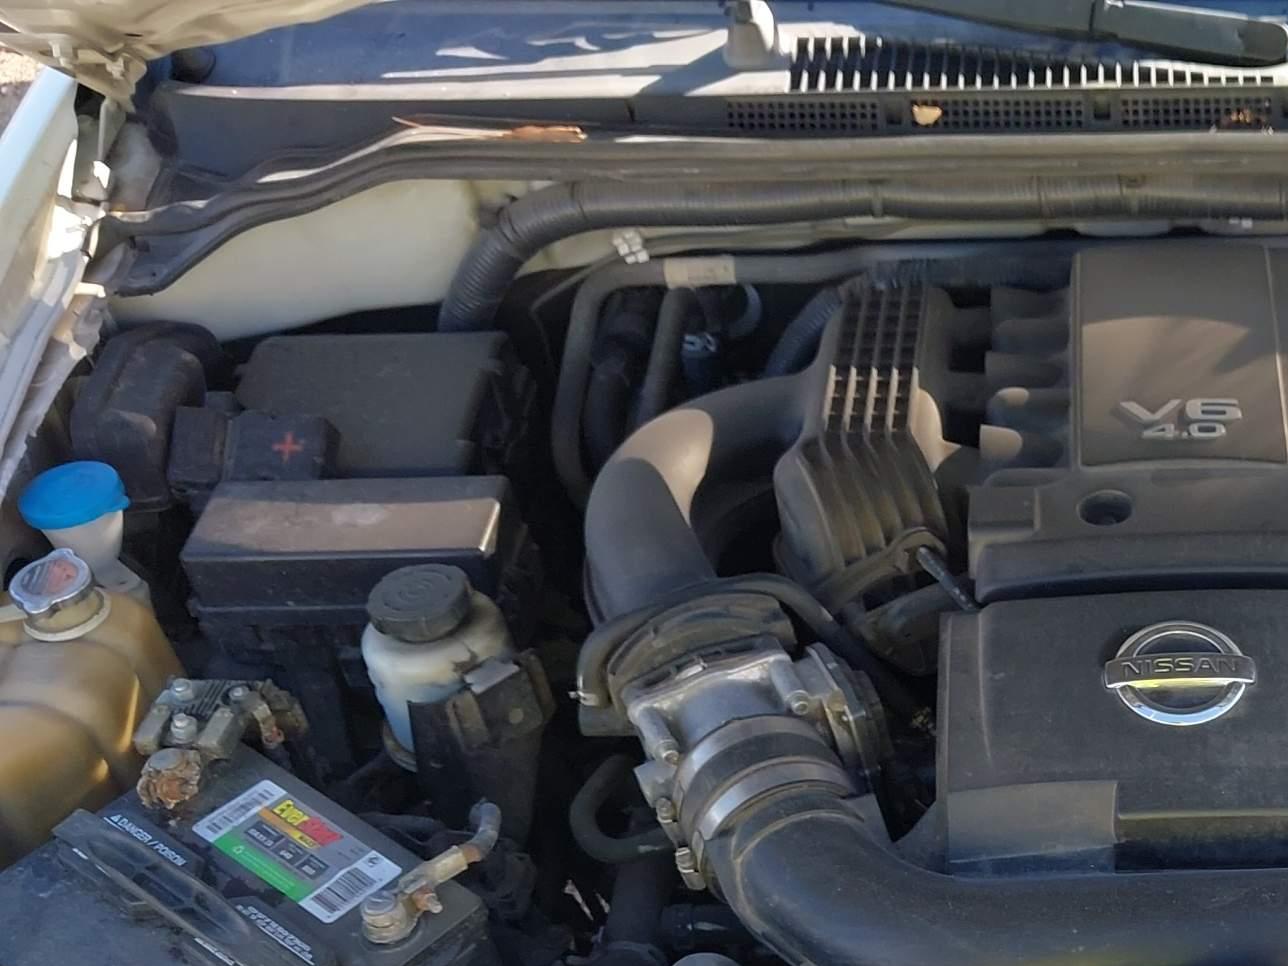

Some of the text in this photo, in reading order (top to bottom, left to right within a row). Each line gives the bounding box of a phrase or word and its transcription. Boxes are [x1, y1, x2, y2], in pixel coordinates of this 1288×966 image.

[1119, 398, 1242, 423] V6
[1141, 422, 1227, 440] 4.0
[1120, 656, 1238, 678] NISSAN
[117, 818, 153, 843] DANGER
